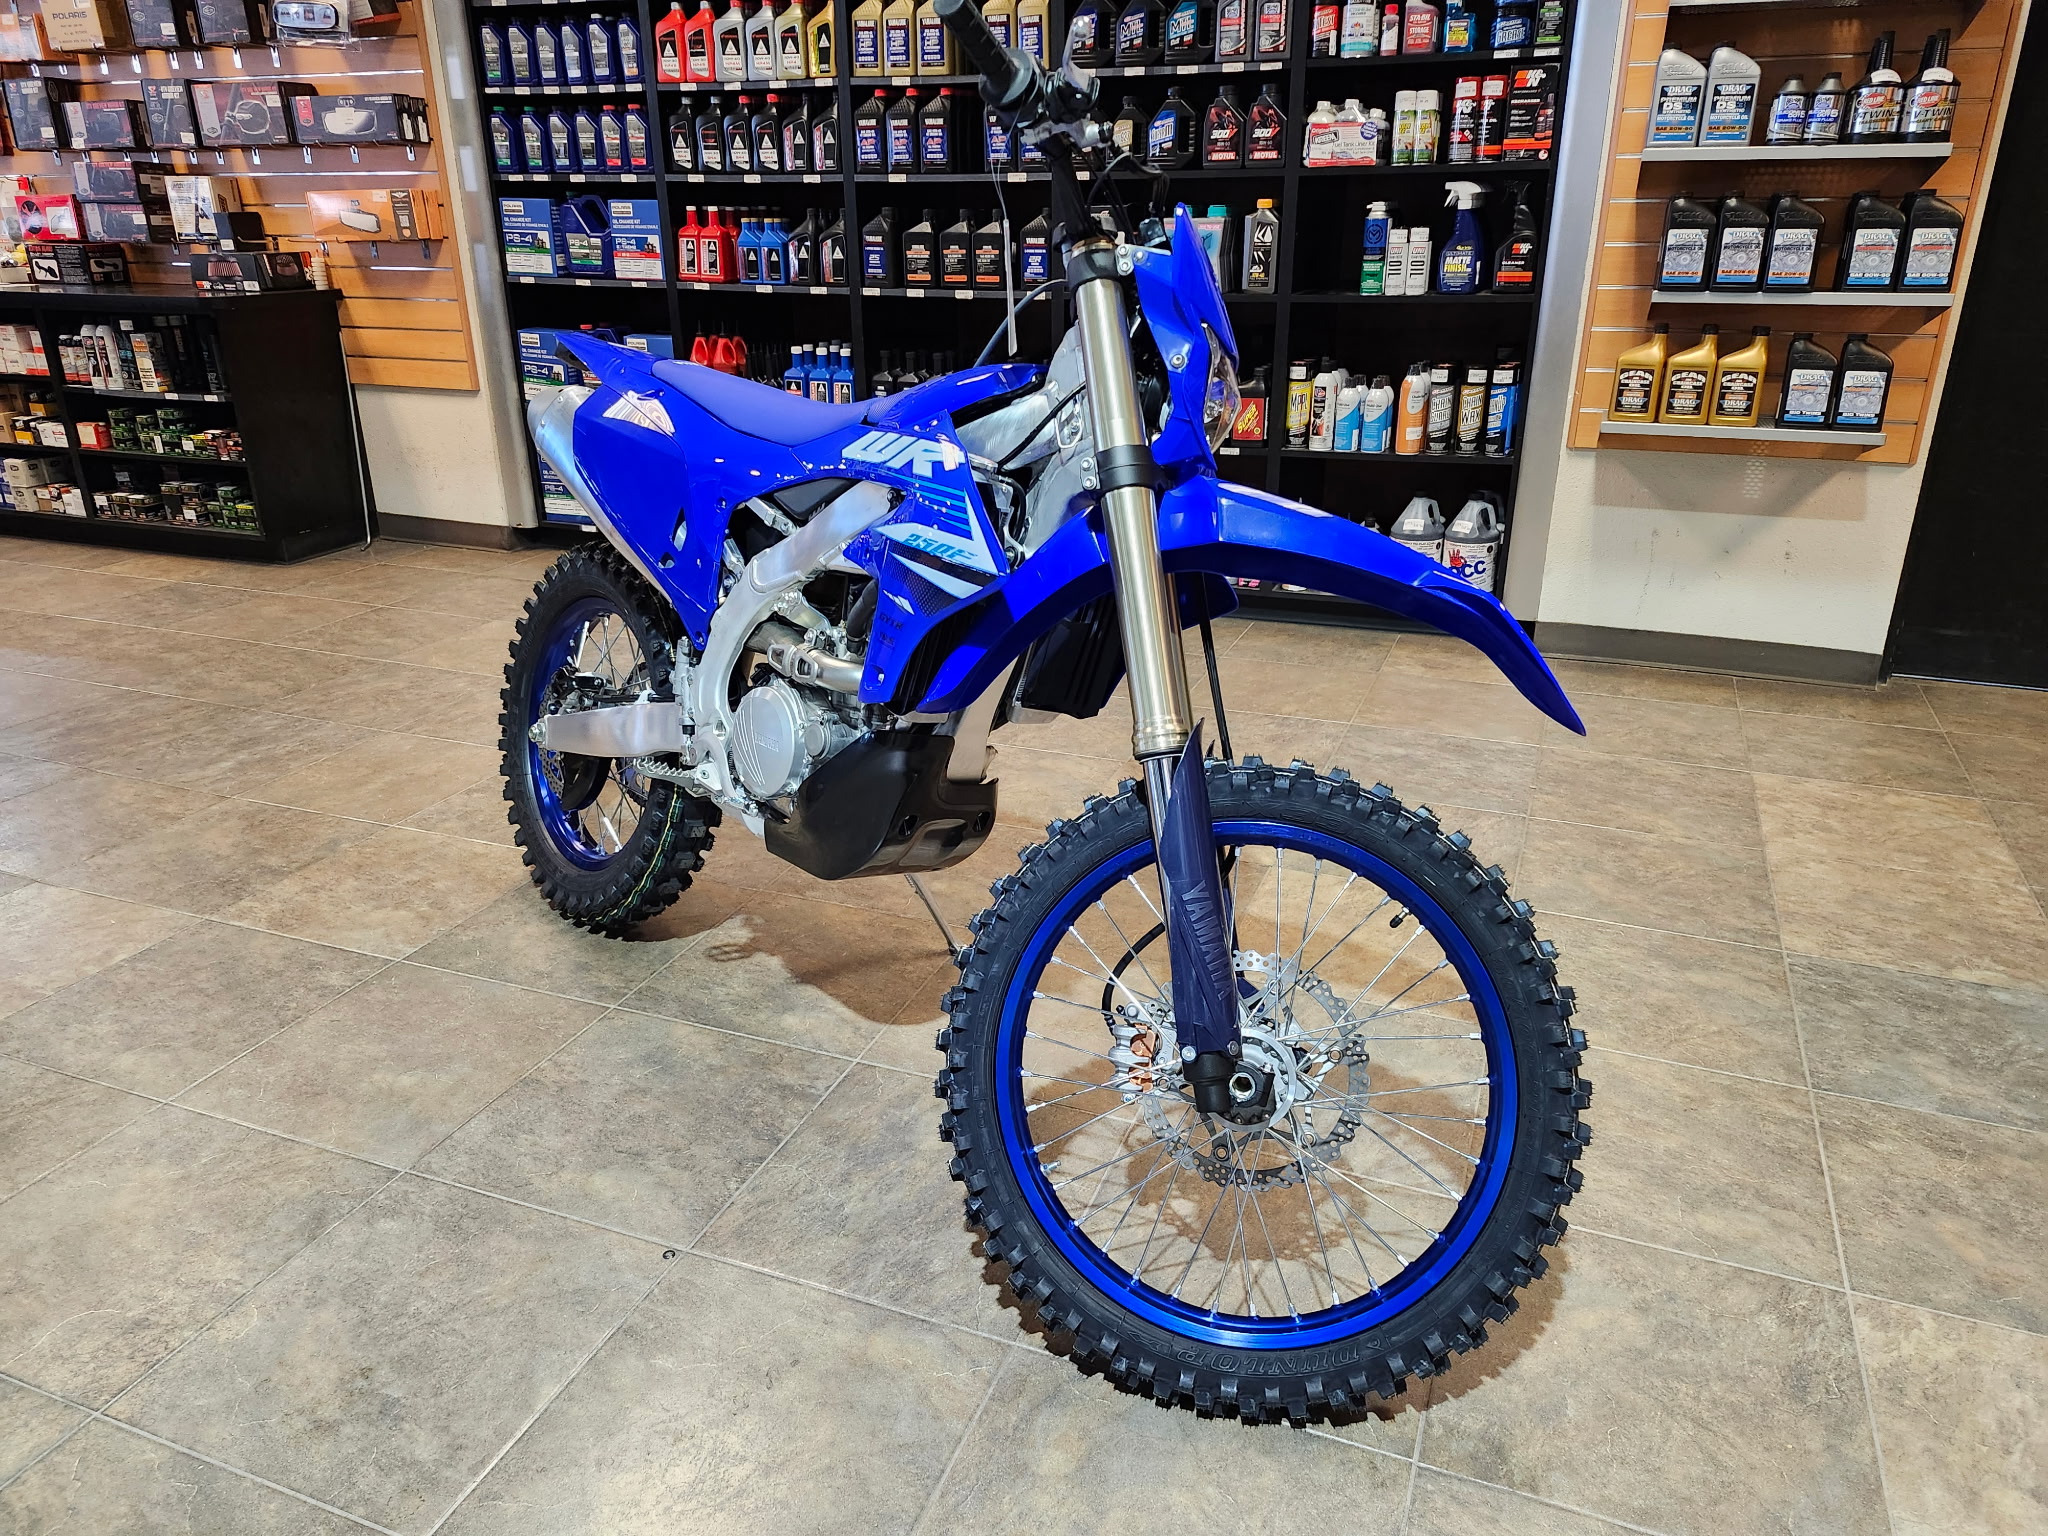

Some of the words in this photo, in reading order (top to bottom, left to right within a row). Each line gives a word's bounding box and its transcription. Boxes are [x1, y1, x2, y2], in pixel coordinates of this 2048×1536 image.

[52, 11, 88, 20] POLARIS
[1212, 152, 1236, 160] MOTUL
[1254, 151, 1278, 159] MOTUL
[506, 233, 532, 243] PS-4
[1445, 256, 1472, 264] MATTE
[1388, 261, 1402, 278] OIL
[1410, 260, 1425, 278] OIL
[1444, 264, 1466, 272] FINISH
[524, 365, 549, 375] PS-4
[1620, 370, 1653, 381] GEAR
[1672, 371, 1706, 383] GEAR
[1722, 372, 1757, 384] GEAR
[1463, 394, 1484, 409] CHAIN
[1461, 407, 1481, 426] WAX
[842, 431, 965, 479] WR
[1181, 879, 1233, 1001] YAMAHA
[1177, 1346, 1362, 1377] DUNLOP
